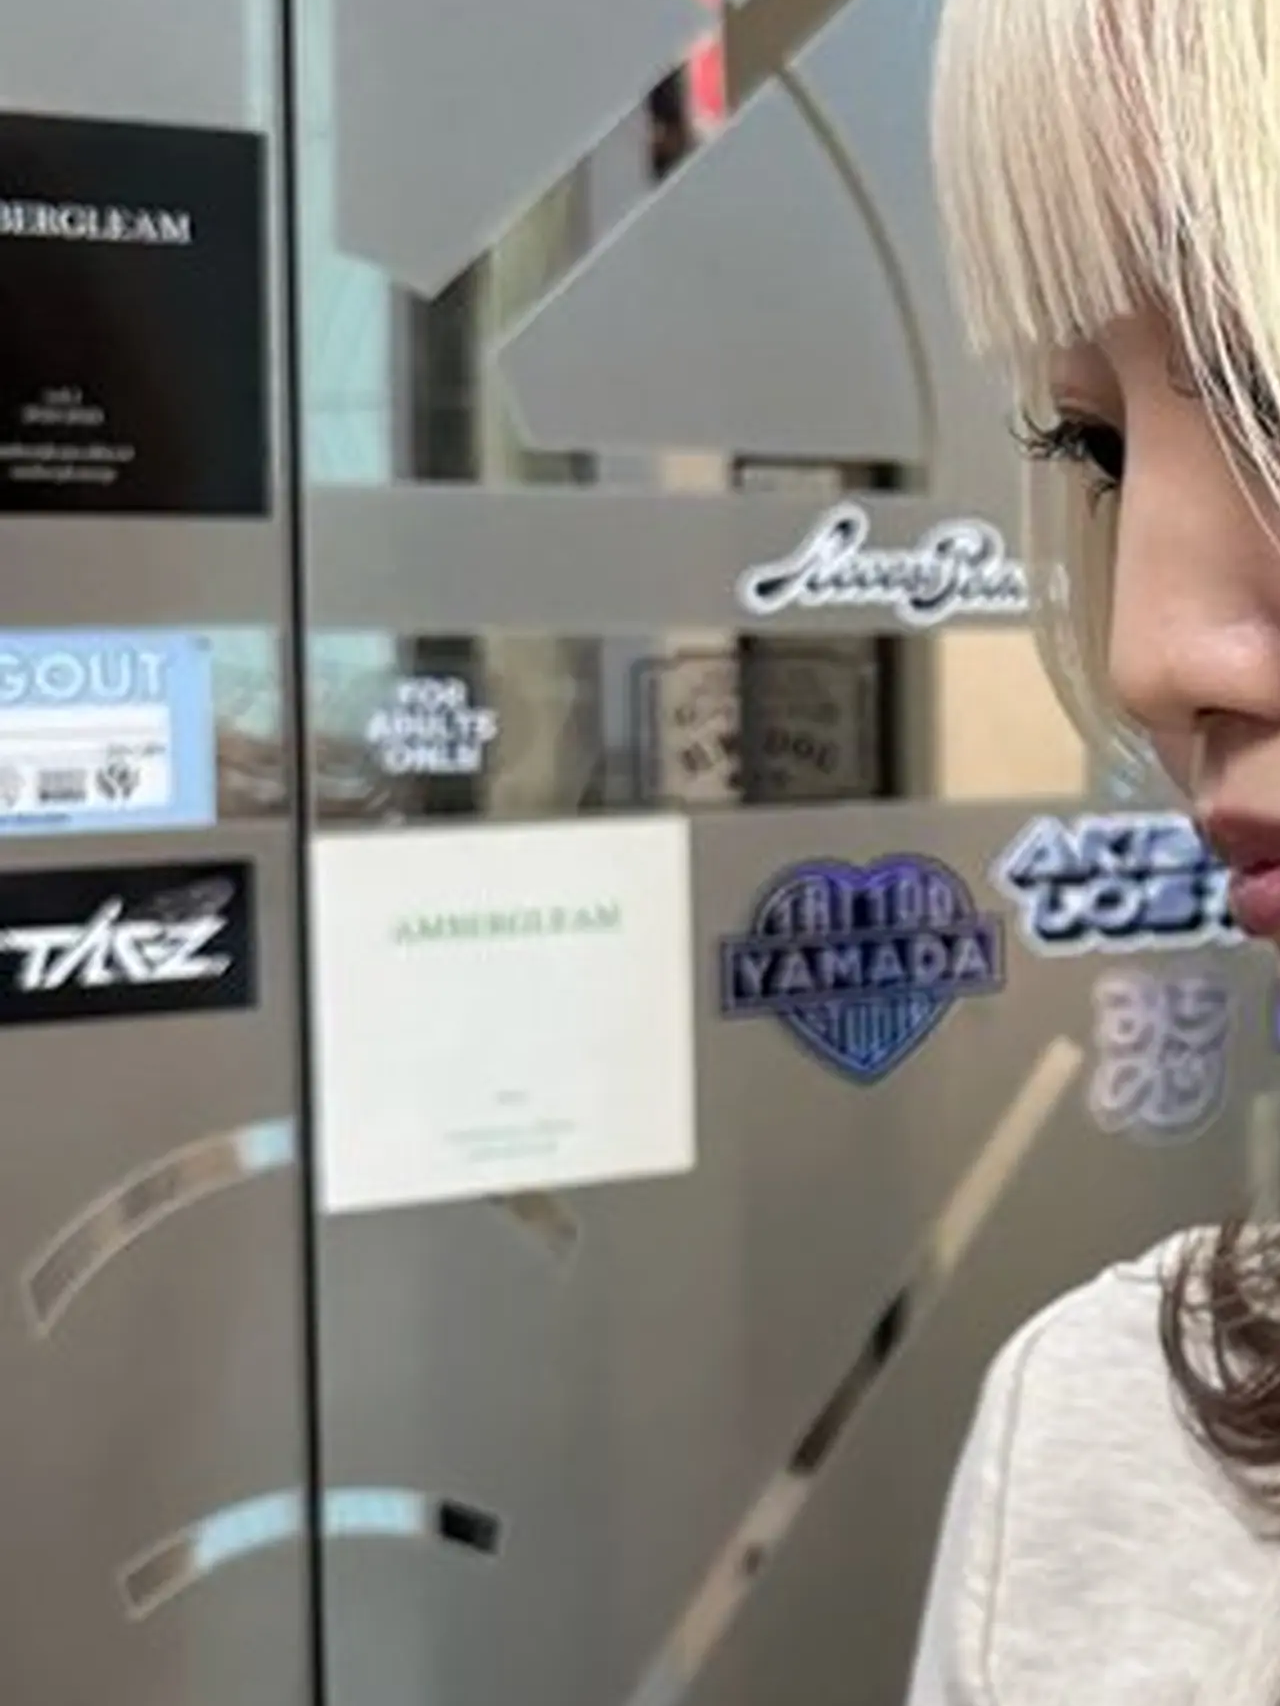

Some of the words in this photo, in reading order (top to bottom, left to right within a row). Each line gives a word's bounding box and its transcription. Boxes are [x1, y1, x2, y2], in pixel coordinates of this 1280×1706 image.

[398, 678, 468, 708] FOR
[364, 708, 499, 743] ADULTS
[383, 743, 482, 774] ONLY
[735, 931, 992, 997] YAMADA
